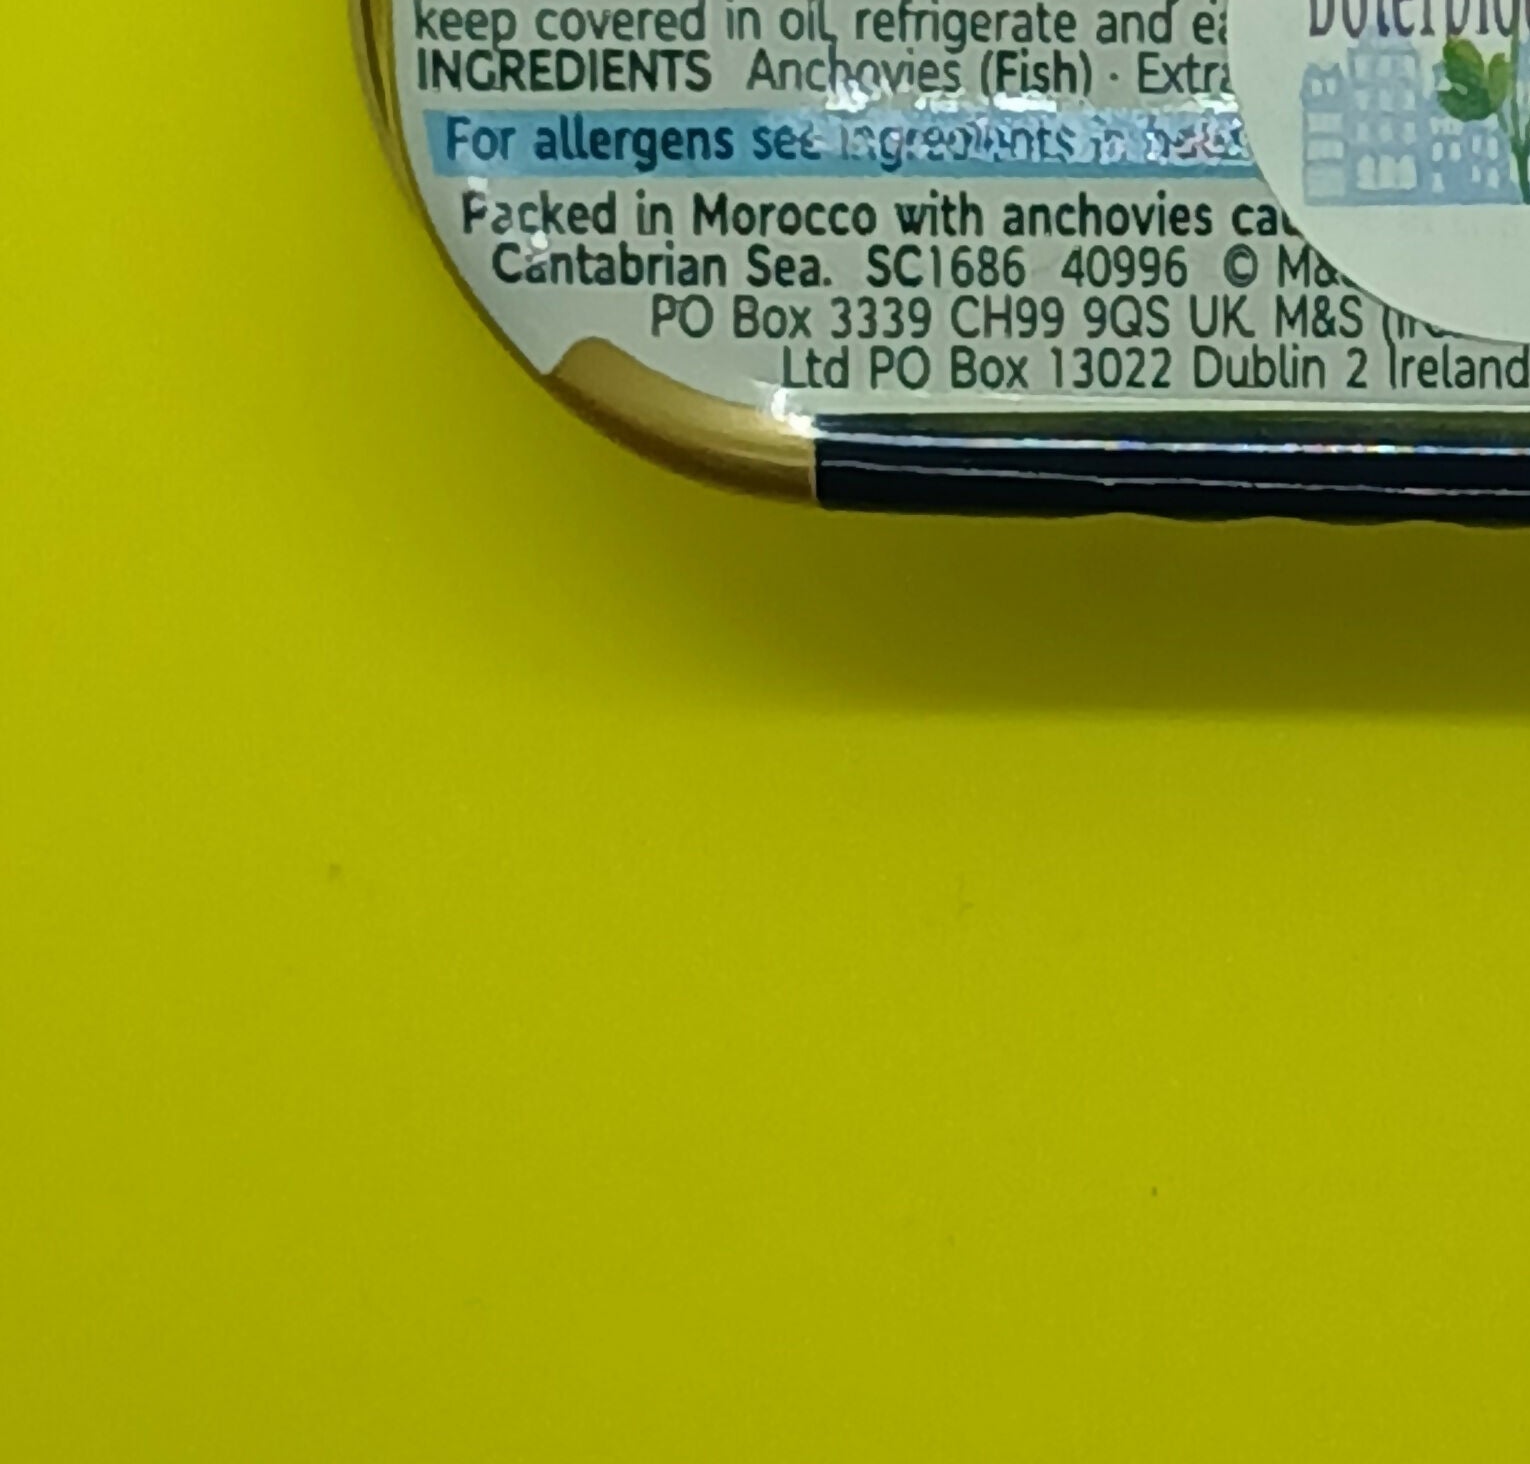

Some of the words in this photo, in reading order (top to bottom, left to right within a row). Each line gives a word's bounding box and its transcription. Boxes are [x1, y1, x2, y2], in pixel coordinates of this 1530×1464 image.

[1096, 1, 1173, 45] and
[417, 48, 712, 92] INGREDIENTS
[746, 47, 961, 93] Anchovies
[980, 49, 1093, 95] (Fish)
[446, 116, 515, 161] For
[534, 112, 734, 173] allergens
[753, 123, 821, 160] see
[462, 182, 616, 235] Packed
[636, 189, 673, 235] in
[693, 191, 877, 236] Morocco
[896, 189, 983, 236] with
[1002, 190, 1212, 236] anchovies
[492, 240, 727, 287] Cantabrian
[746, 244, 833, 287] Sea.
[867, 244, 1025, 288] SC1686
[1061, 244, 1187, 288] 40996
[1278, 244, 1358, 288] M&
[651, 294, 713, 337] PO
[733, 294, 812, 337] Box
[831, 296, 931, 338] 3339
[950, 294, 1064, 338] CH99
[1083, 294, 1170, 338] 9QS
[1275, 294, 1363, 338] M&S
[782, 345, 849, 389] Ltd
[870, 345, 930, 390] PO
[950, 345, 1029, 389] Box
[1050, 345, 1171, 389] 13022
[1194, 342, 1325, 388] Dublin
[1347, 347, 1367, 388] 2
[1388, 342, 1530, 389] Ireland
